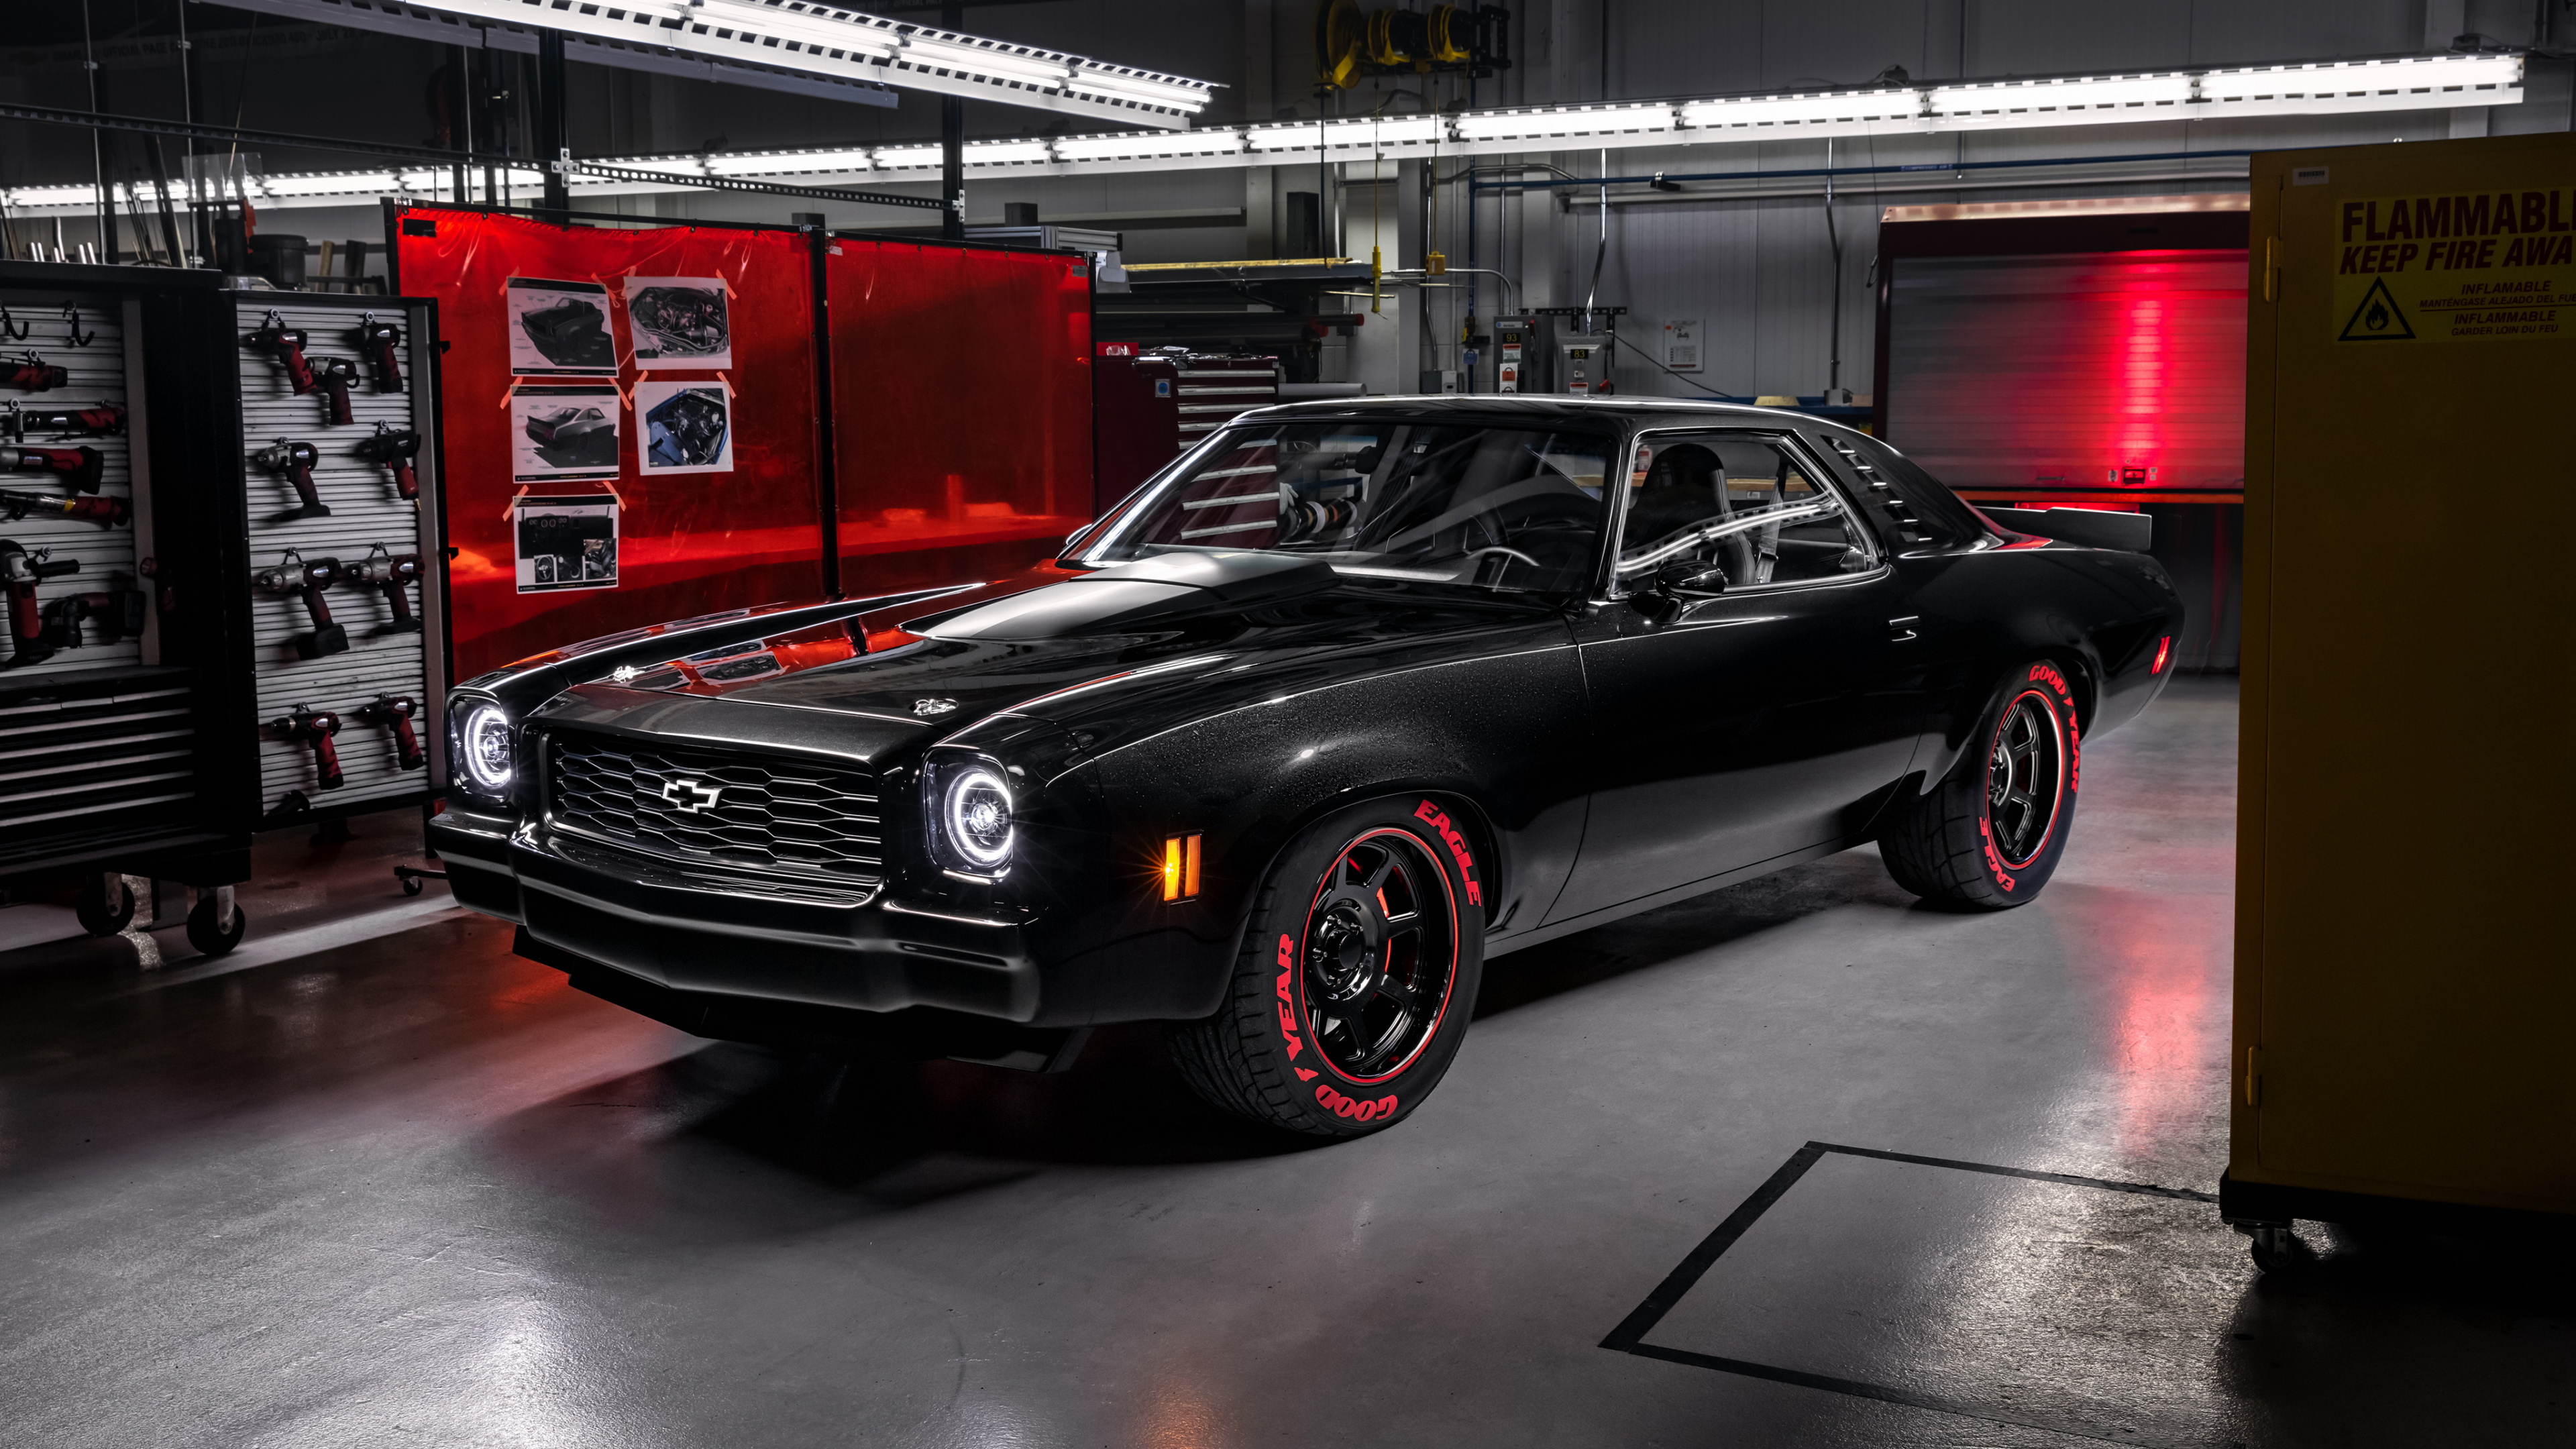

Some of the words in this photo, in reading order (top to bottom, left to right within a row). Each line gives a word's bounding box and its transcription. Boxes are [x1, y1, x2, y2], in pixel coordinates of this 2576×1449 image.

[2339, 243, 2418, 275] KEEP
[2425, 239, 2497, 271] FIRE
[2502, 235, 2573, 267] AWA
[2461, 280, 2552, 294] INFLAMABLE
[2420, 296, 2487, 308] MANTÉNGASE
[2488, 295, 2534, 306] ALEJADO
[2536, 294, 2555, 303] DEL
[2454, 310, 2556, 325] INFLAMMABLE
[2451, 326, 2492, 336] GARDER
[2496, 325, 2521, 335] LOIN
[2523, 325, 2537, 333] DU
[2538, 324, 2559, 333] FEU
[1506, 333, 1517, 342] 93
[1574, 350, 1585, 358] 83
[1413, 799, 1481, 907] EAGLE
[1979, 816, 2015, 893] EAGLE
